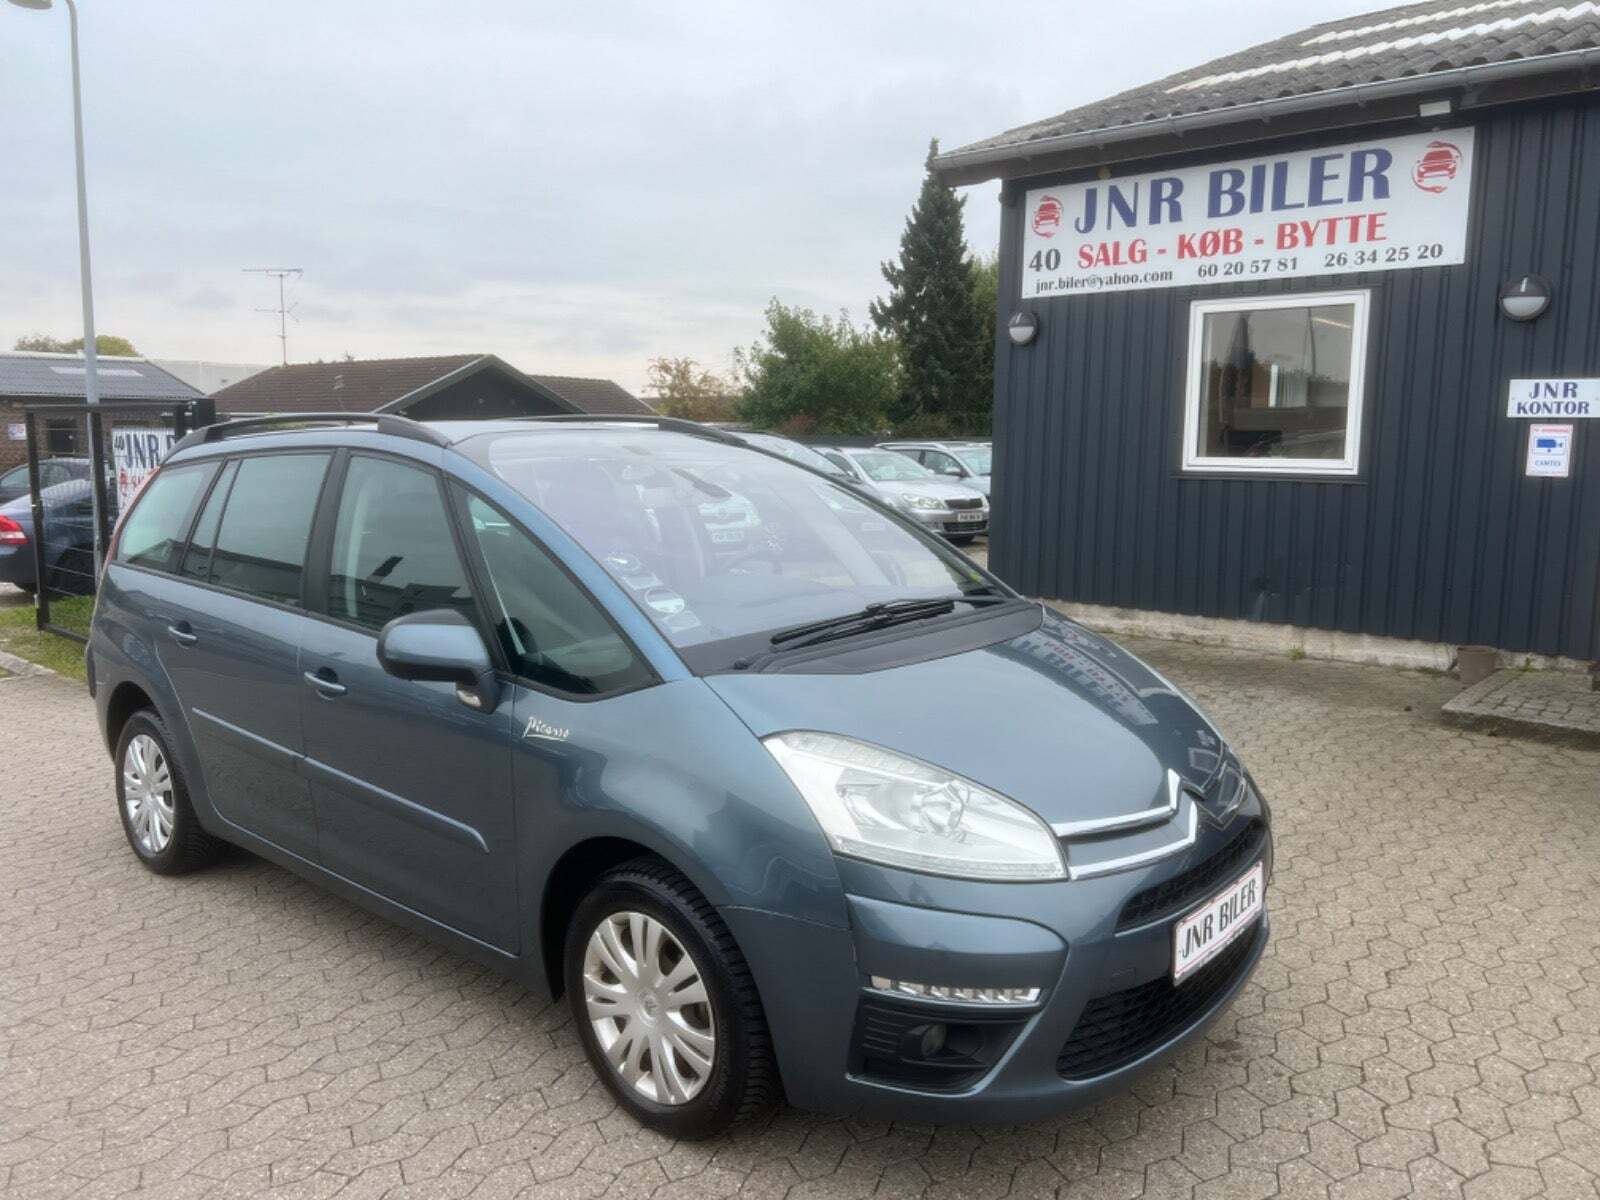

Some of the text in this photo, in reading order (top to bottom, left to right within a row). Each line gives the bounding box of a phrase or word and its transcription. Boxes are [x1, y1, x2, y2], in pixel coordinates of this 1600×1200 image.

[1075, 147, 1393, 234] JNR BILER
[1077, 238, 1148, 269] SALG
[1177, 228, 1243, 258] KØB
[1276, 212, 1387, 250] BYTTE
[1029, 248, 1061, 272] 40
[1198, 257, 1298, 278] 60 20 57 81
[1325, 243, 1443, 268] 26 34 25 20
[1035, 270, 1173, 294] jnr.biler@yahoo.com
[1529, 382, 1578, 399] JNR
[1516, 401, 1590, 415] KONTOR
[126, 433, 160, 469] JNR
[1182, 878, 1256, 959] JNR BILER
